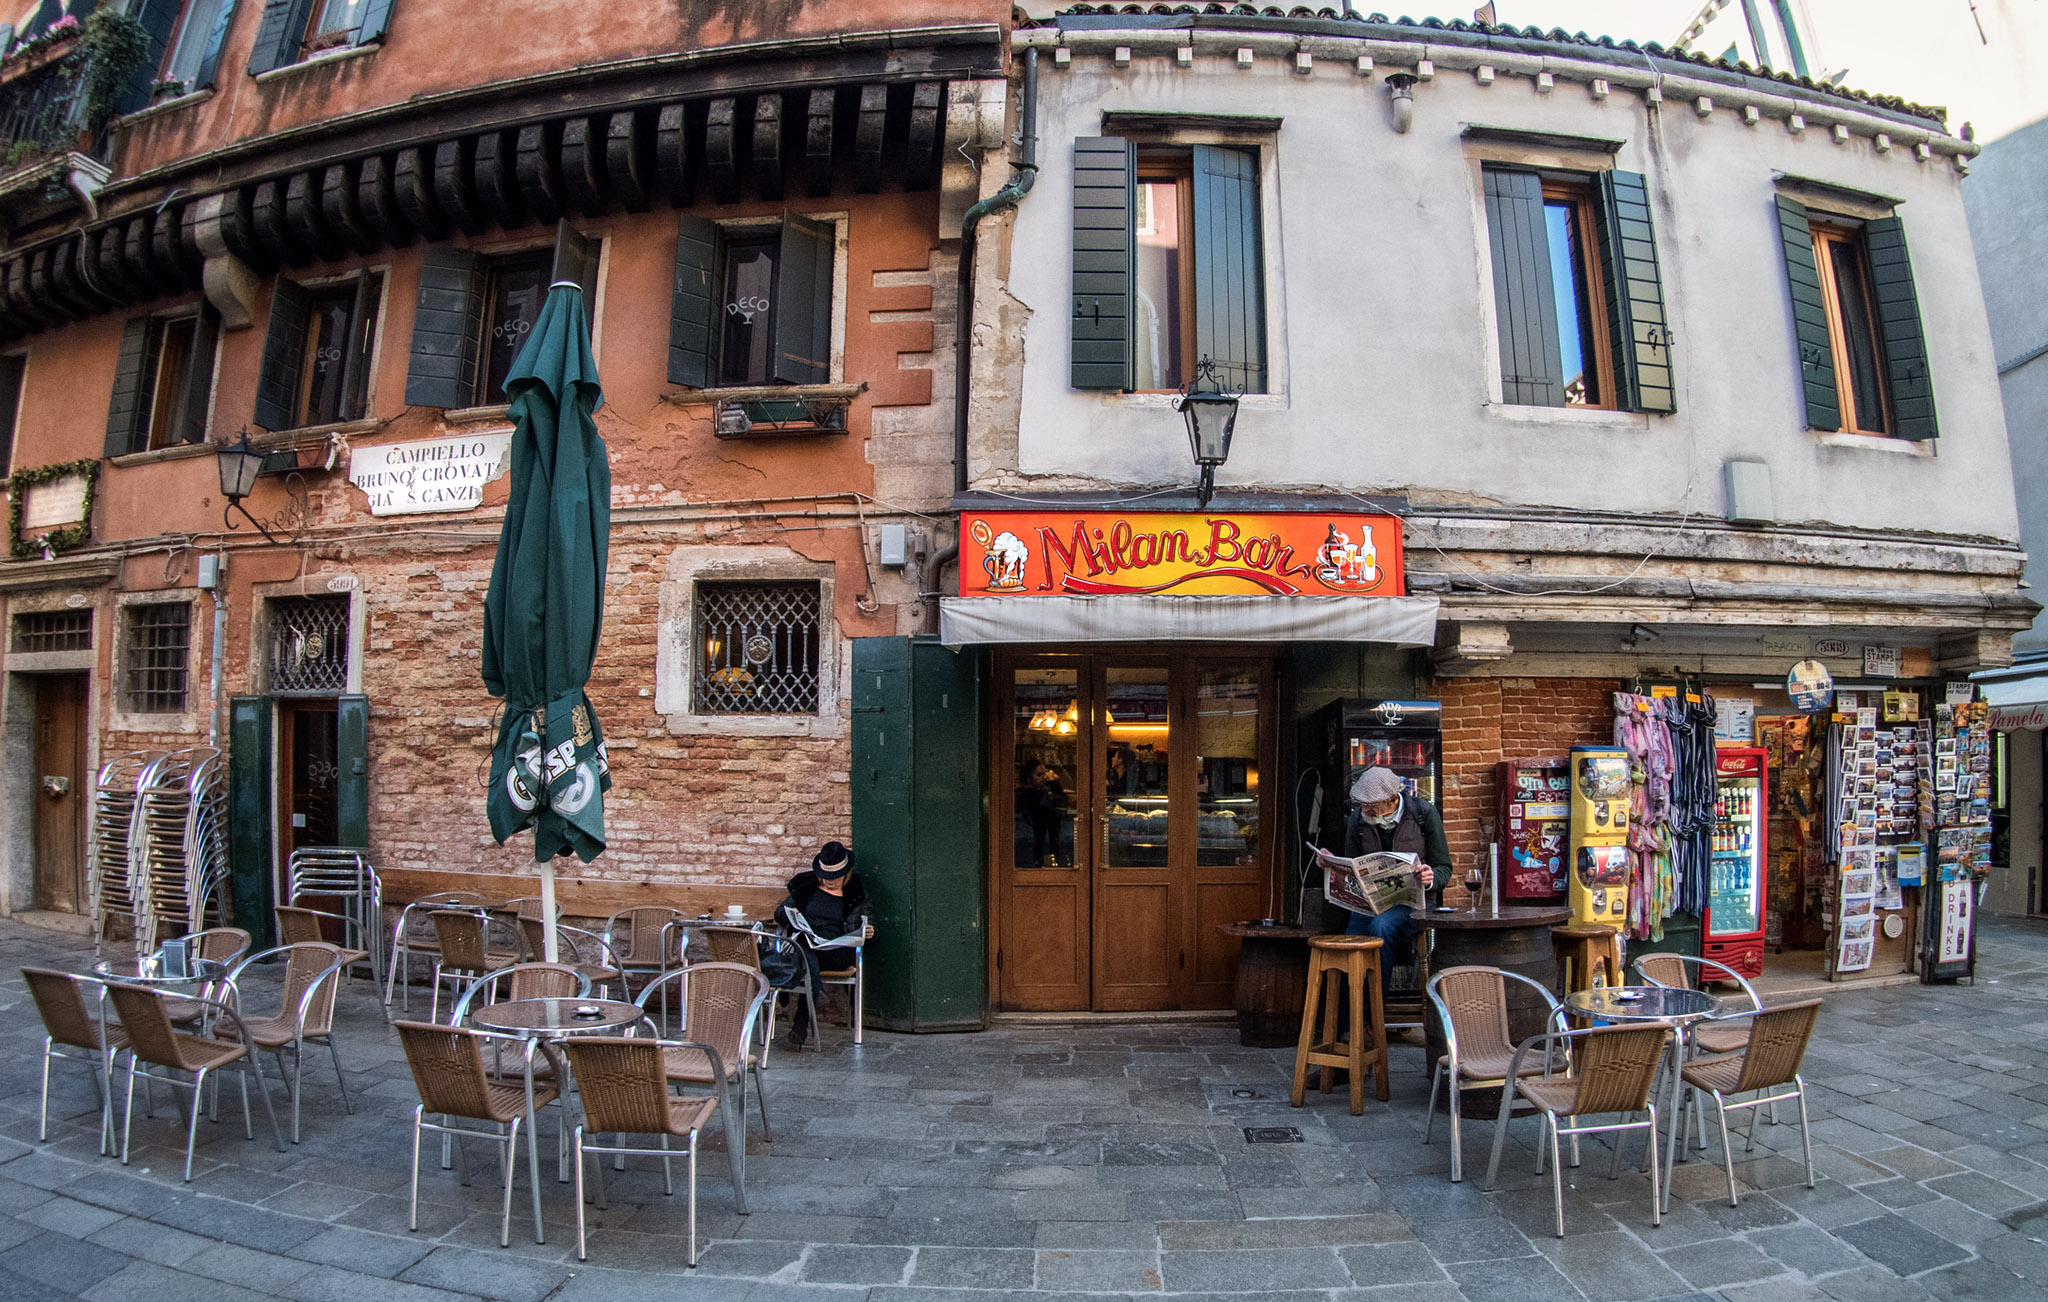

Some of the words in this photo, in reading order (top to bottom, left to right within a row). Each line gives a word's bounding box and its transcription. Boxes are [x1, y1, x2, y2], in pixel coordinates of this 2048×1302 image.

[727, 295, 770, 316] DECO
[493, 318, 530, 339] DECO
[386, 442, 486, 465] CAMPIELLO
[356, 470, 413, 490] BRUNO
[422, 461, 498, 482] CROVAT
[421, 485, 479, 504] CANZI
[1034, 518, 1200, 592] Milan
[1198, 516, 1312, 579] Bar
[1763, 640, 1806, 653] TABACCHI
[1866, 652, 1895, 662] STAMPS
[1947, 682, 1971, 690] STAMPS
[1989, 705, 2045, 729] Pamela
[1945, 893, 1956, 956] DRINKS
